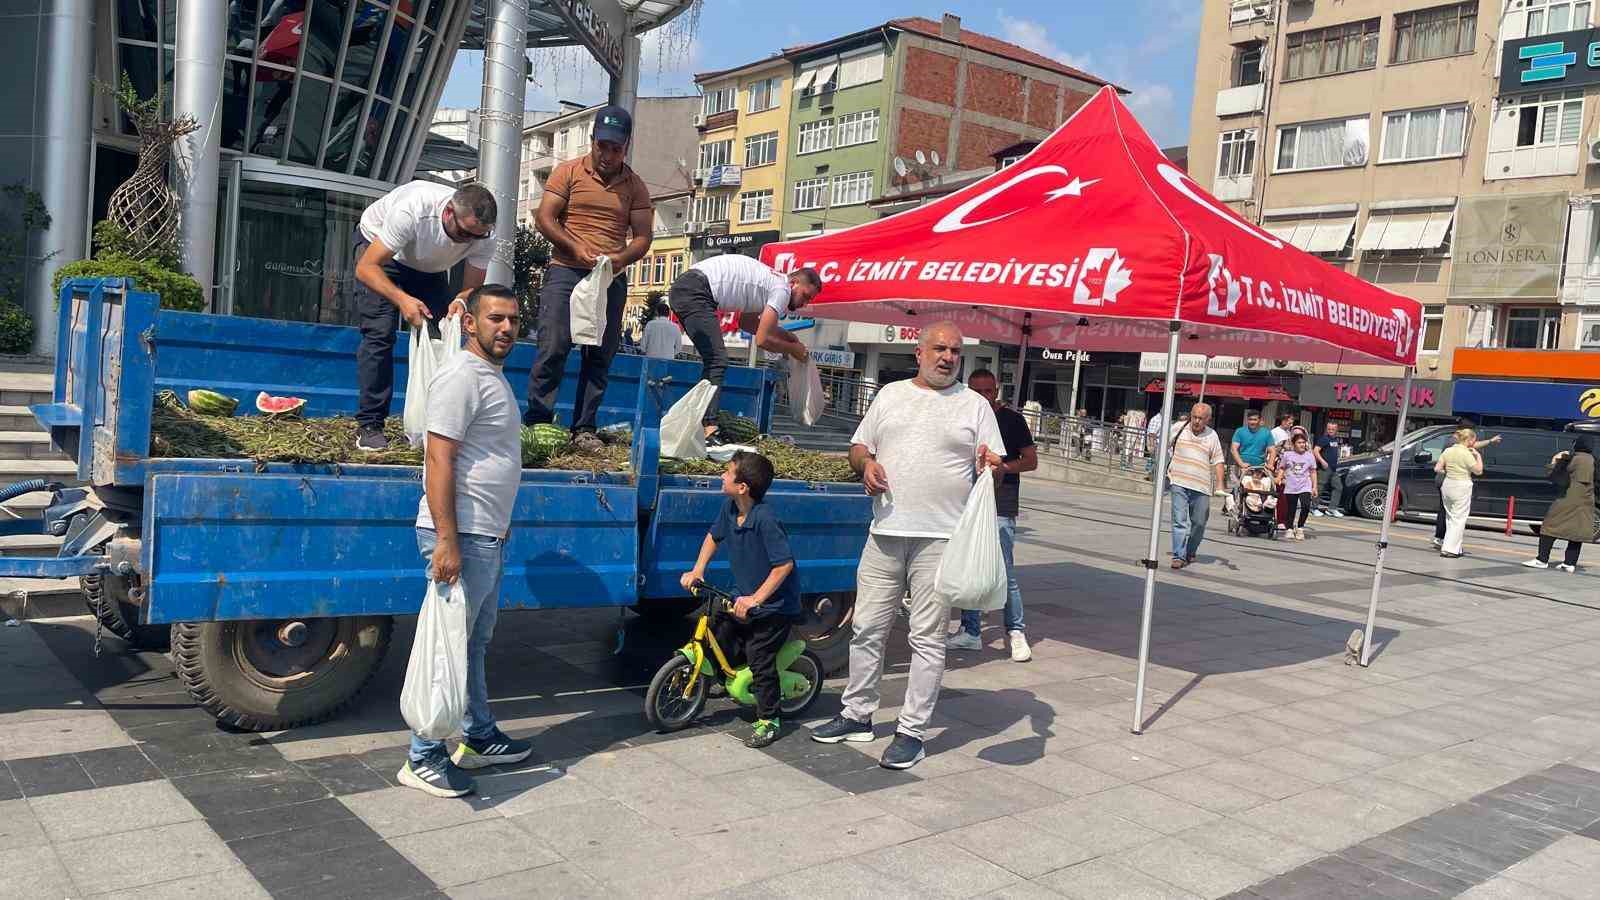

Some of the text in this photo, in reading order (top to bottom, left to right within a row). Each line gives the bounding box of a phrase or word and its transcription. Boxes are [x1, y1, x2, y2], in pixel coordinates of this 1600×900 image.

[847, 256, 917, 281] İZMİT
[918, 258, 1080, 288] BELEDİYESİ
[1240, 276, 1281, 310] T.C.
[1280, 281, 1325, 320] İZMİT
